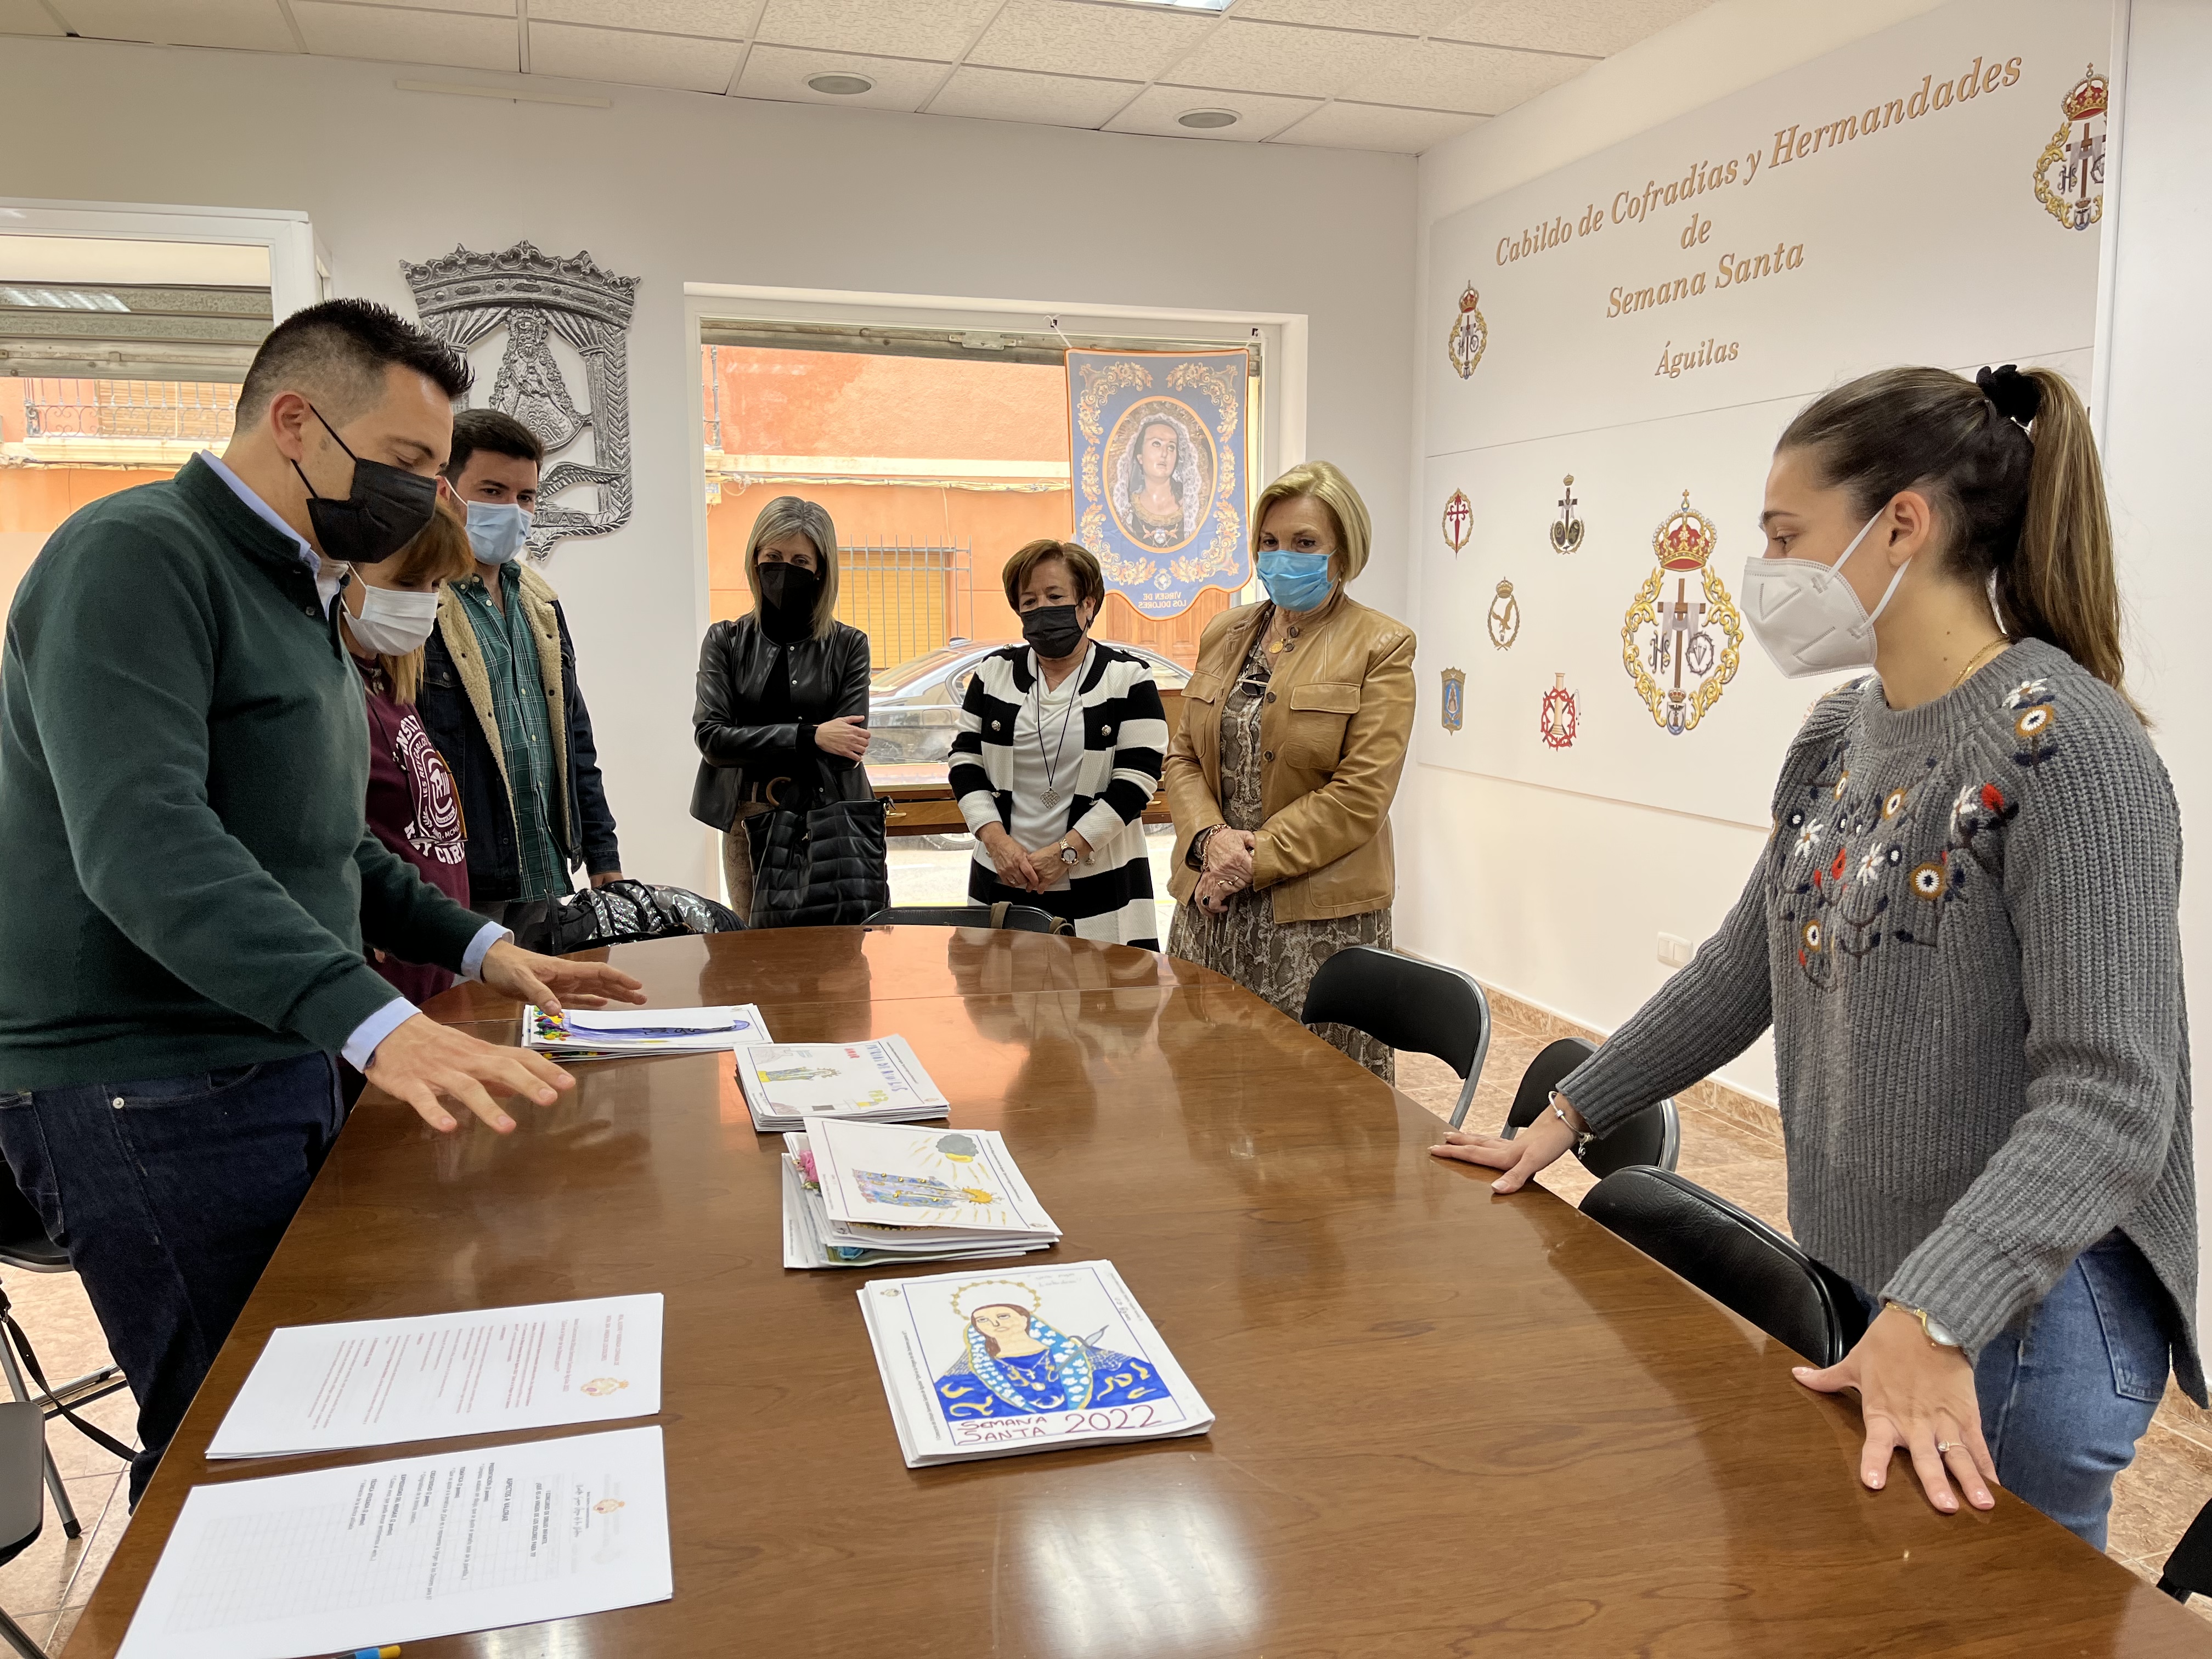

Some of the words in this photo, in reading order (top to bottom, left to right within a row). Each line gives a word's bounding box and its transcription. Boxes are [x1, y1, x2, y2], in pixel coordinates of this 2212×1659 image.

[1497, 216, 1572, 266] Cabildo
[1578, 204, 1604, 236] de
[1612, 160, 1738, 224] Cofradías
[1743, 150, 1761, 185] y
[1768, 57, 2022, 168] Hermandades
[1681, 213, 1711, 249] de
[1607, 272, 1706, 318] Semana
[1715, 243, 1803, 288] Santa
[1655, 338, 1739, 379] Águilas
[415, 758, 426, 778] REY
[844, 1048, 860, 1058] AMOR
[957, 1417, 1047, 1431] SEMANA
[1065, 1404, 1162, 1433] 2022
[957, 1427, 1046, 1445] SANTA
[504, 1478, 512, 1497] ASPECTOS
[501, 1502, 510, 1521] VALORAR
